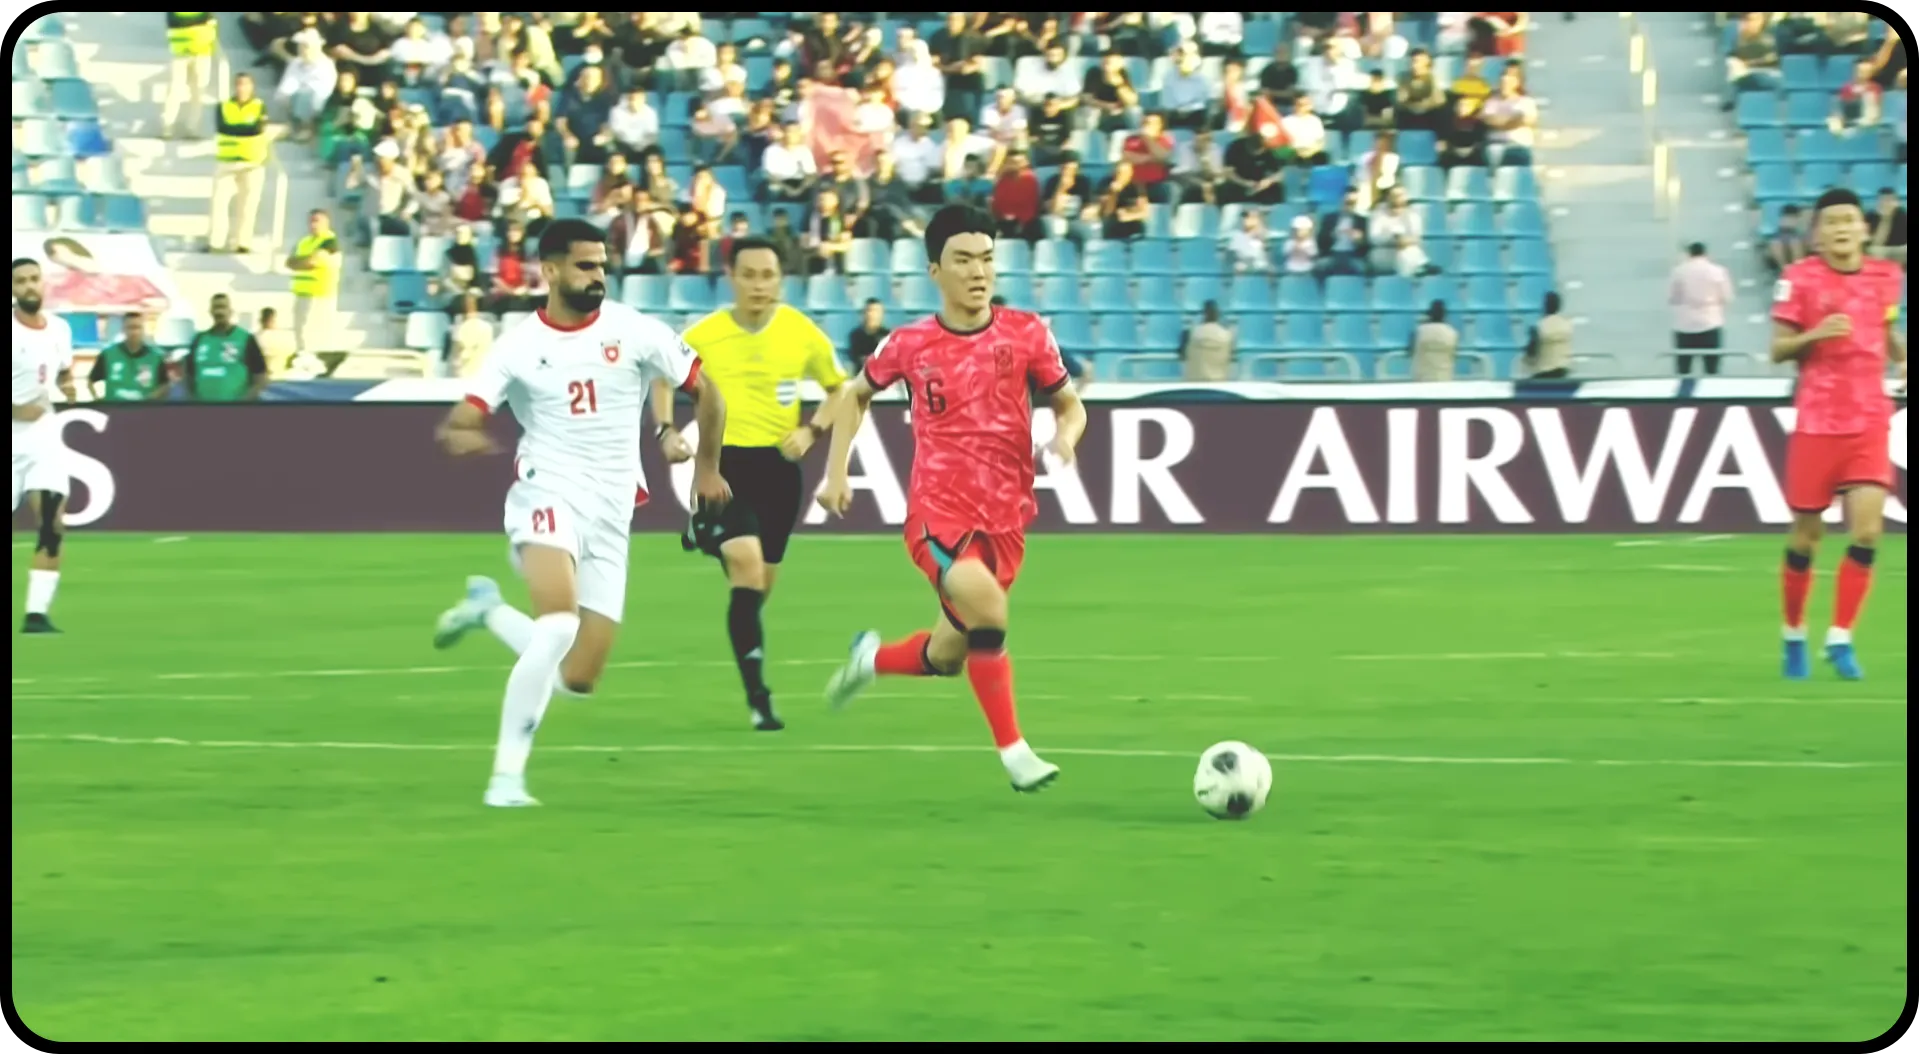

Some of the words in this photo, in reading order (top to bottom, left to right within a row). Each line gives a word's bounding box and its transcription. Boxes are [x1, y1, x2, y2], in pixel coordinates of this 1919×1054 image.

[568, 378, 597, 415] 21
[926, 378, 946, 414] 6
[669, 406, 1205, 526] AAR
[1266, 405, 1907, 525] AIRWA
[532, 506, 556, 534] 21
